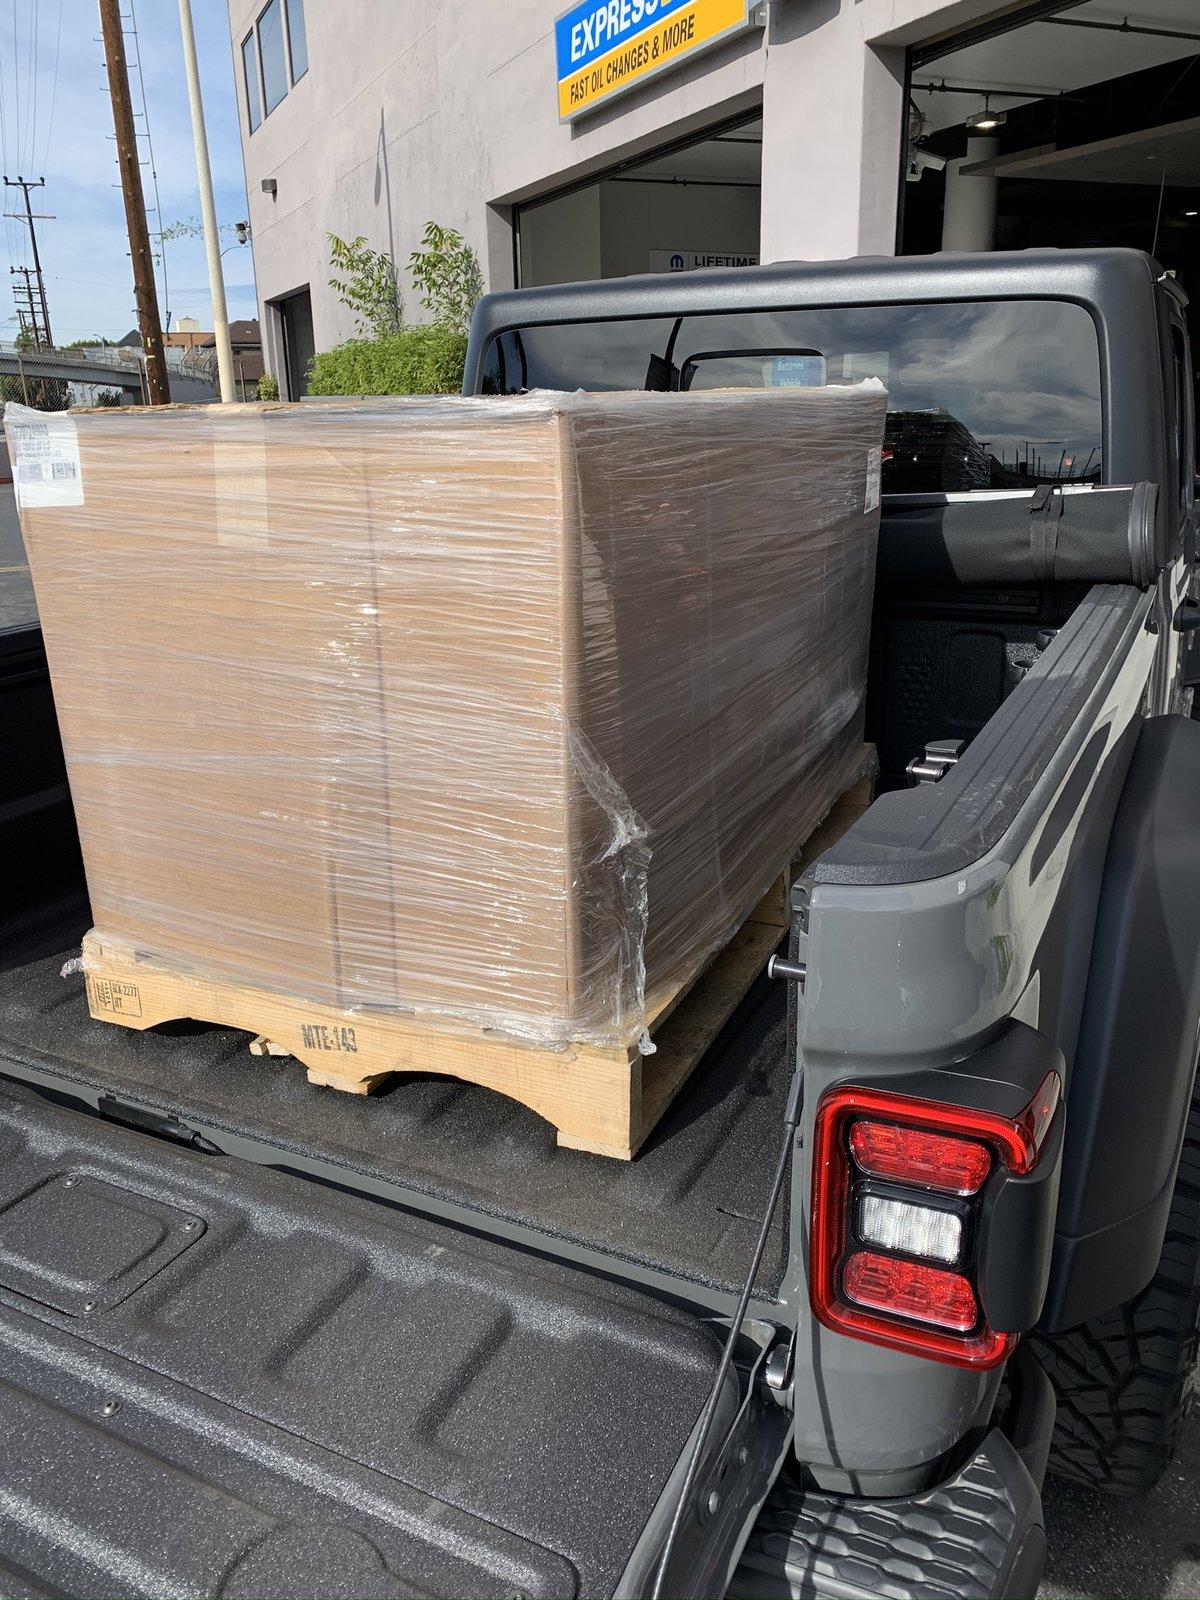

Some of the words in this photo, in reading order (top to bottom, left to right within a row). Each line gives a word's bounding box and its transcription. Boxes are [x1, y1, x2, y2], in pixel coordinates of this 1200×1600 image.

[570, 76, 590, 105] FAST
[591, 68, 604, 93] OIL
[606, 40, 649, 84] CHANGES
[651, 35, 660, 60] &
[662, 13, 695, 53] MORE
[694, 256, 757, 267] LIFETIME
